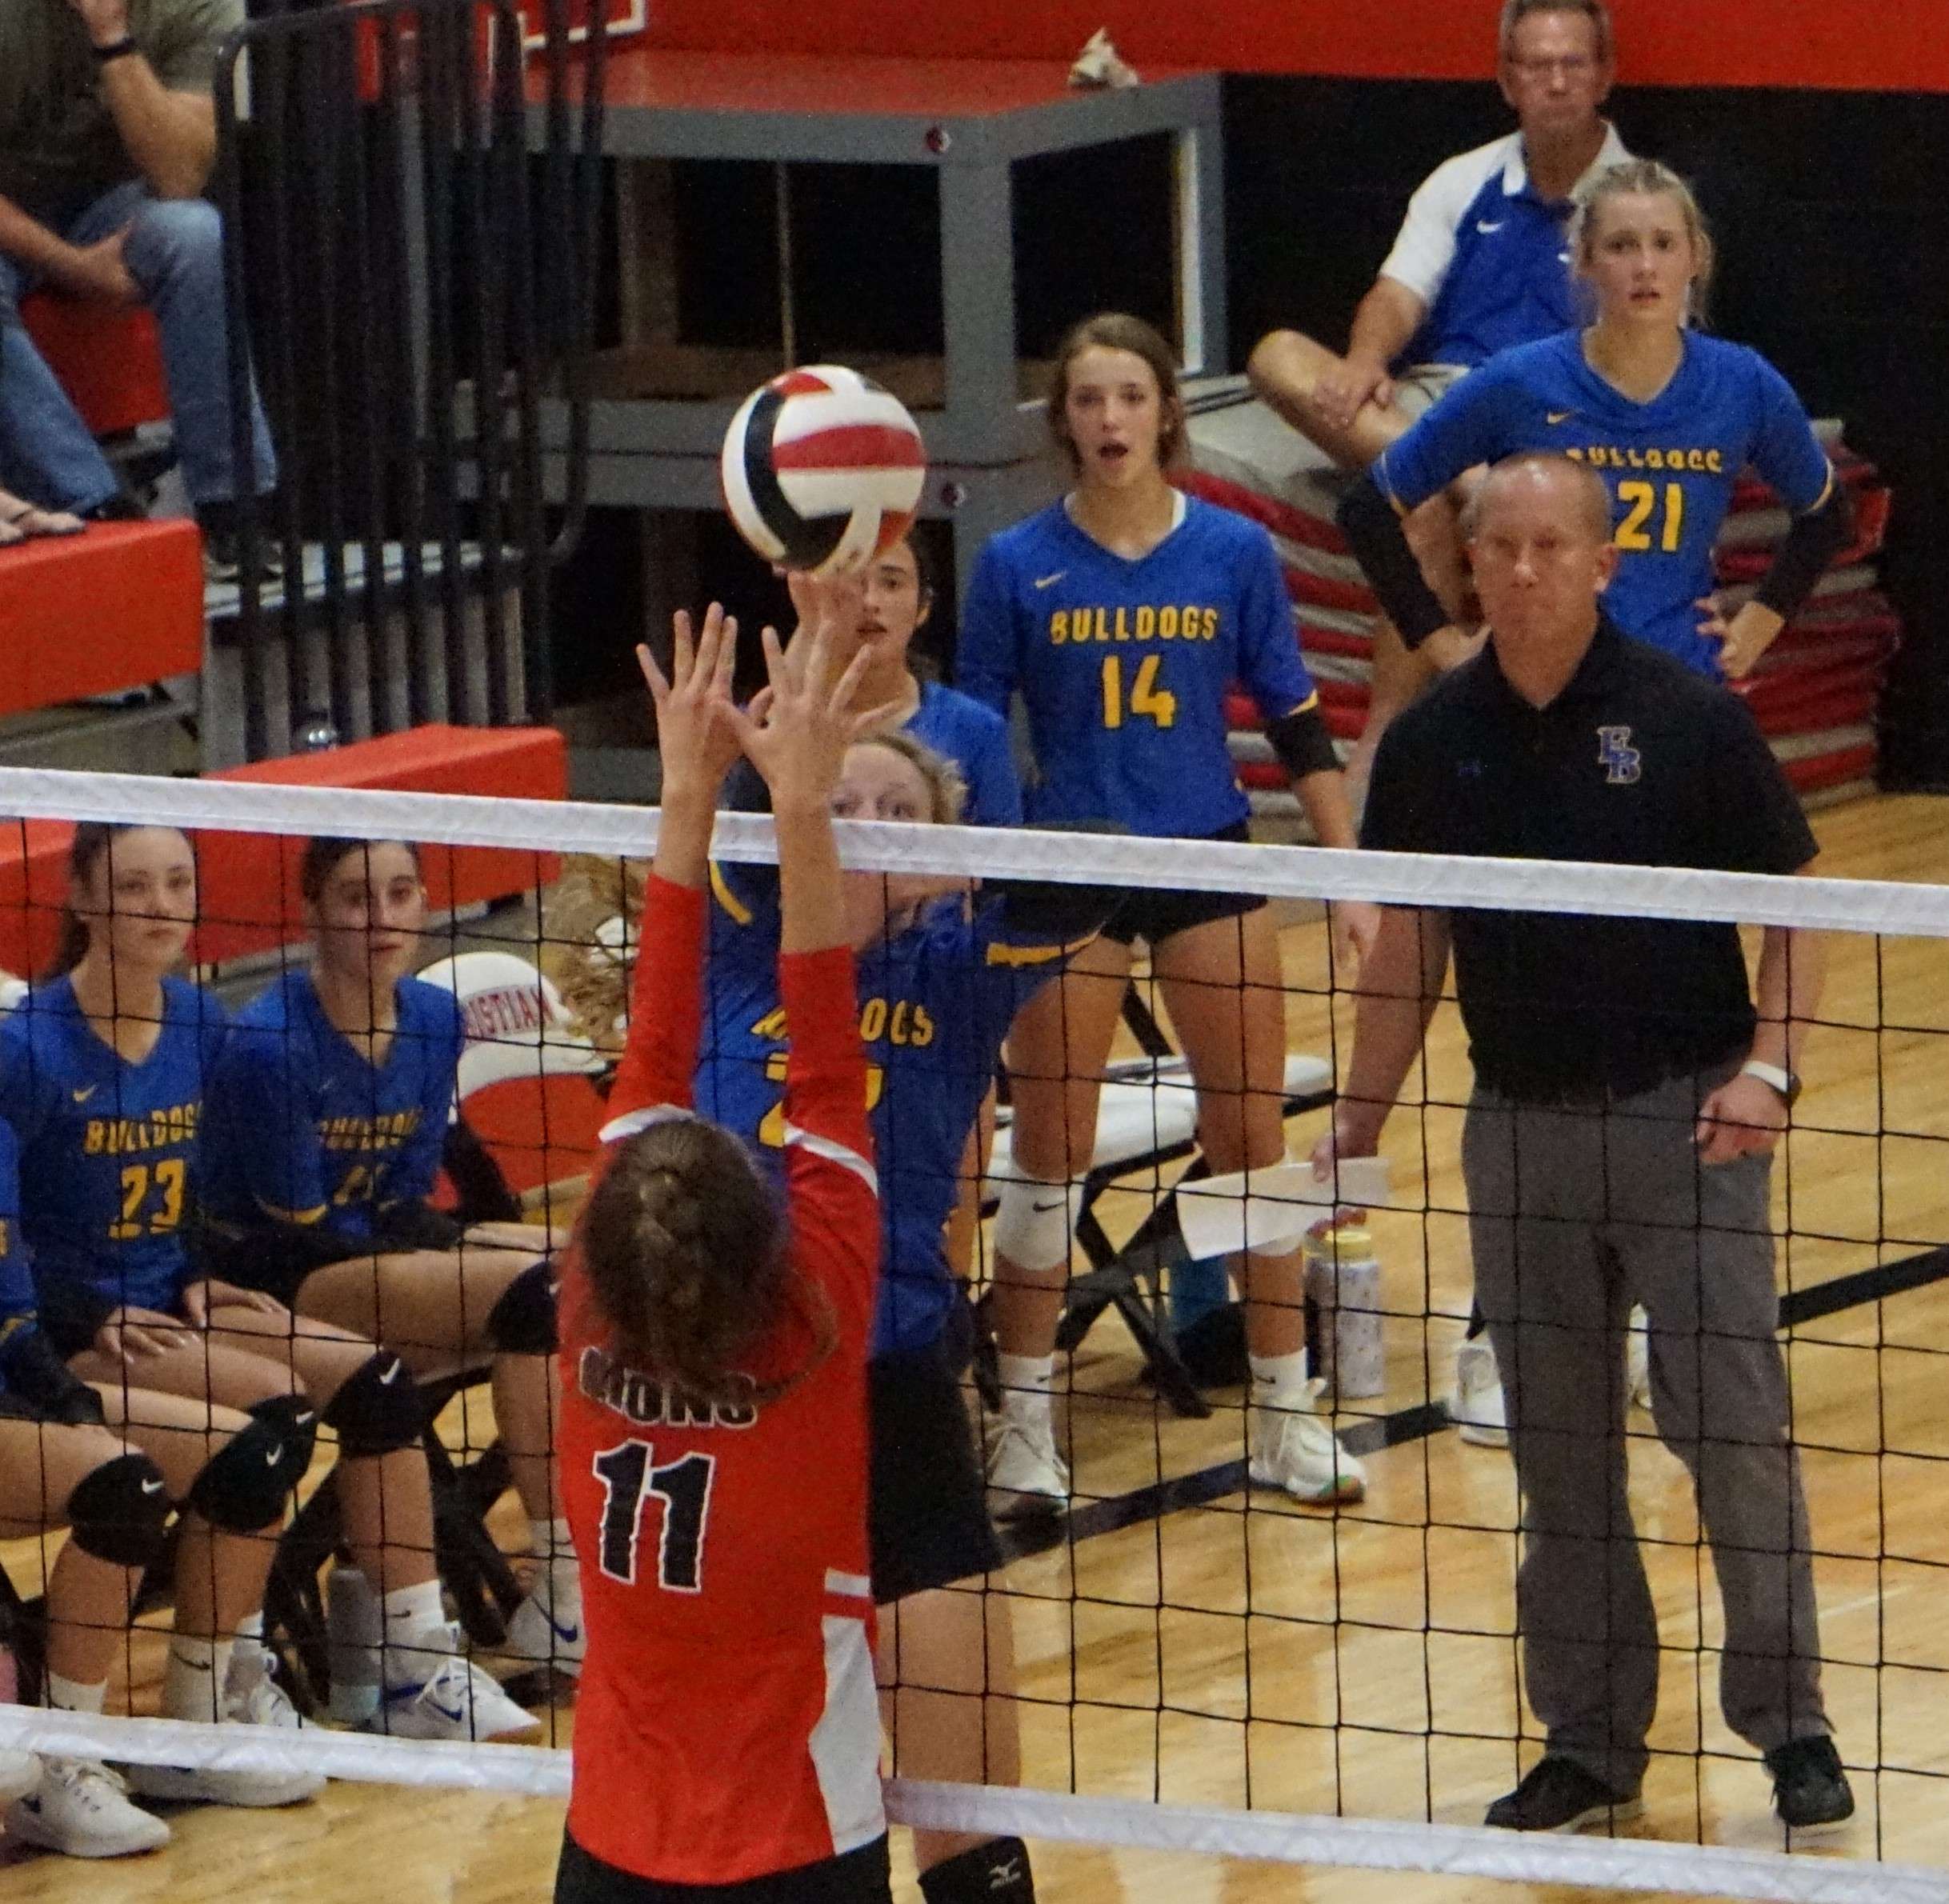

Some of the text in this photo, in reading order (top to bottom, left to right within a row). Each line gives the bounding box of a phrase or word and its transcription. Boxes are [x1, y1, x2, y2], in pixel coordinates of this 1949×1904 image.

[1615, 480, 1683, 551] 21
[1050, 605, 1218, 645] BULLDOGS
[1101, 654, 1176, 728] 14
[84, 1102, 203, 1154] BULLDOG
[108, 1158, 185, 1238] 23
[592, 1438, 715, 1594] 11
